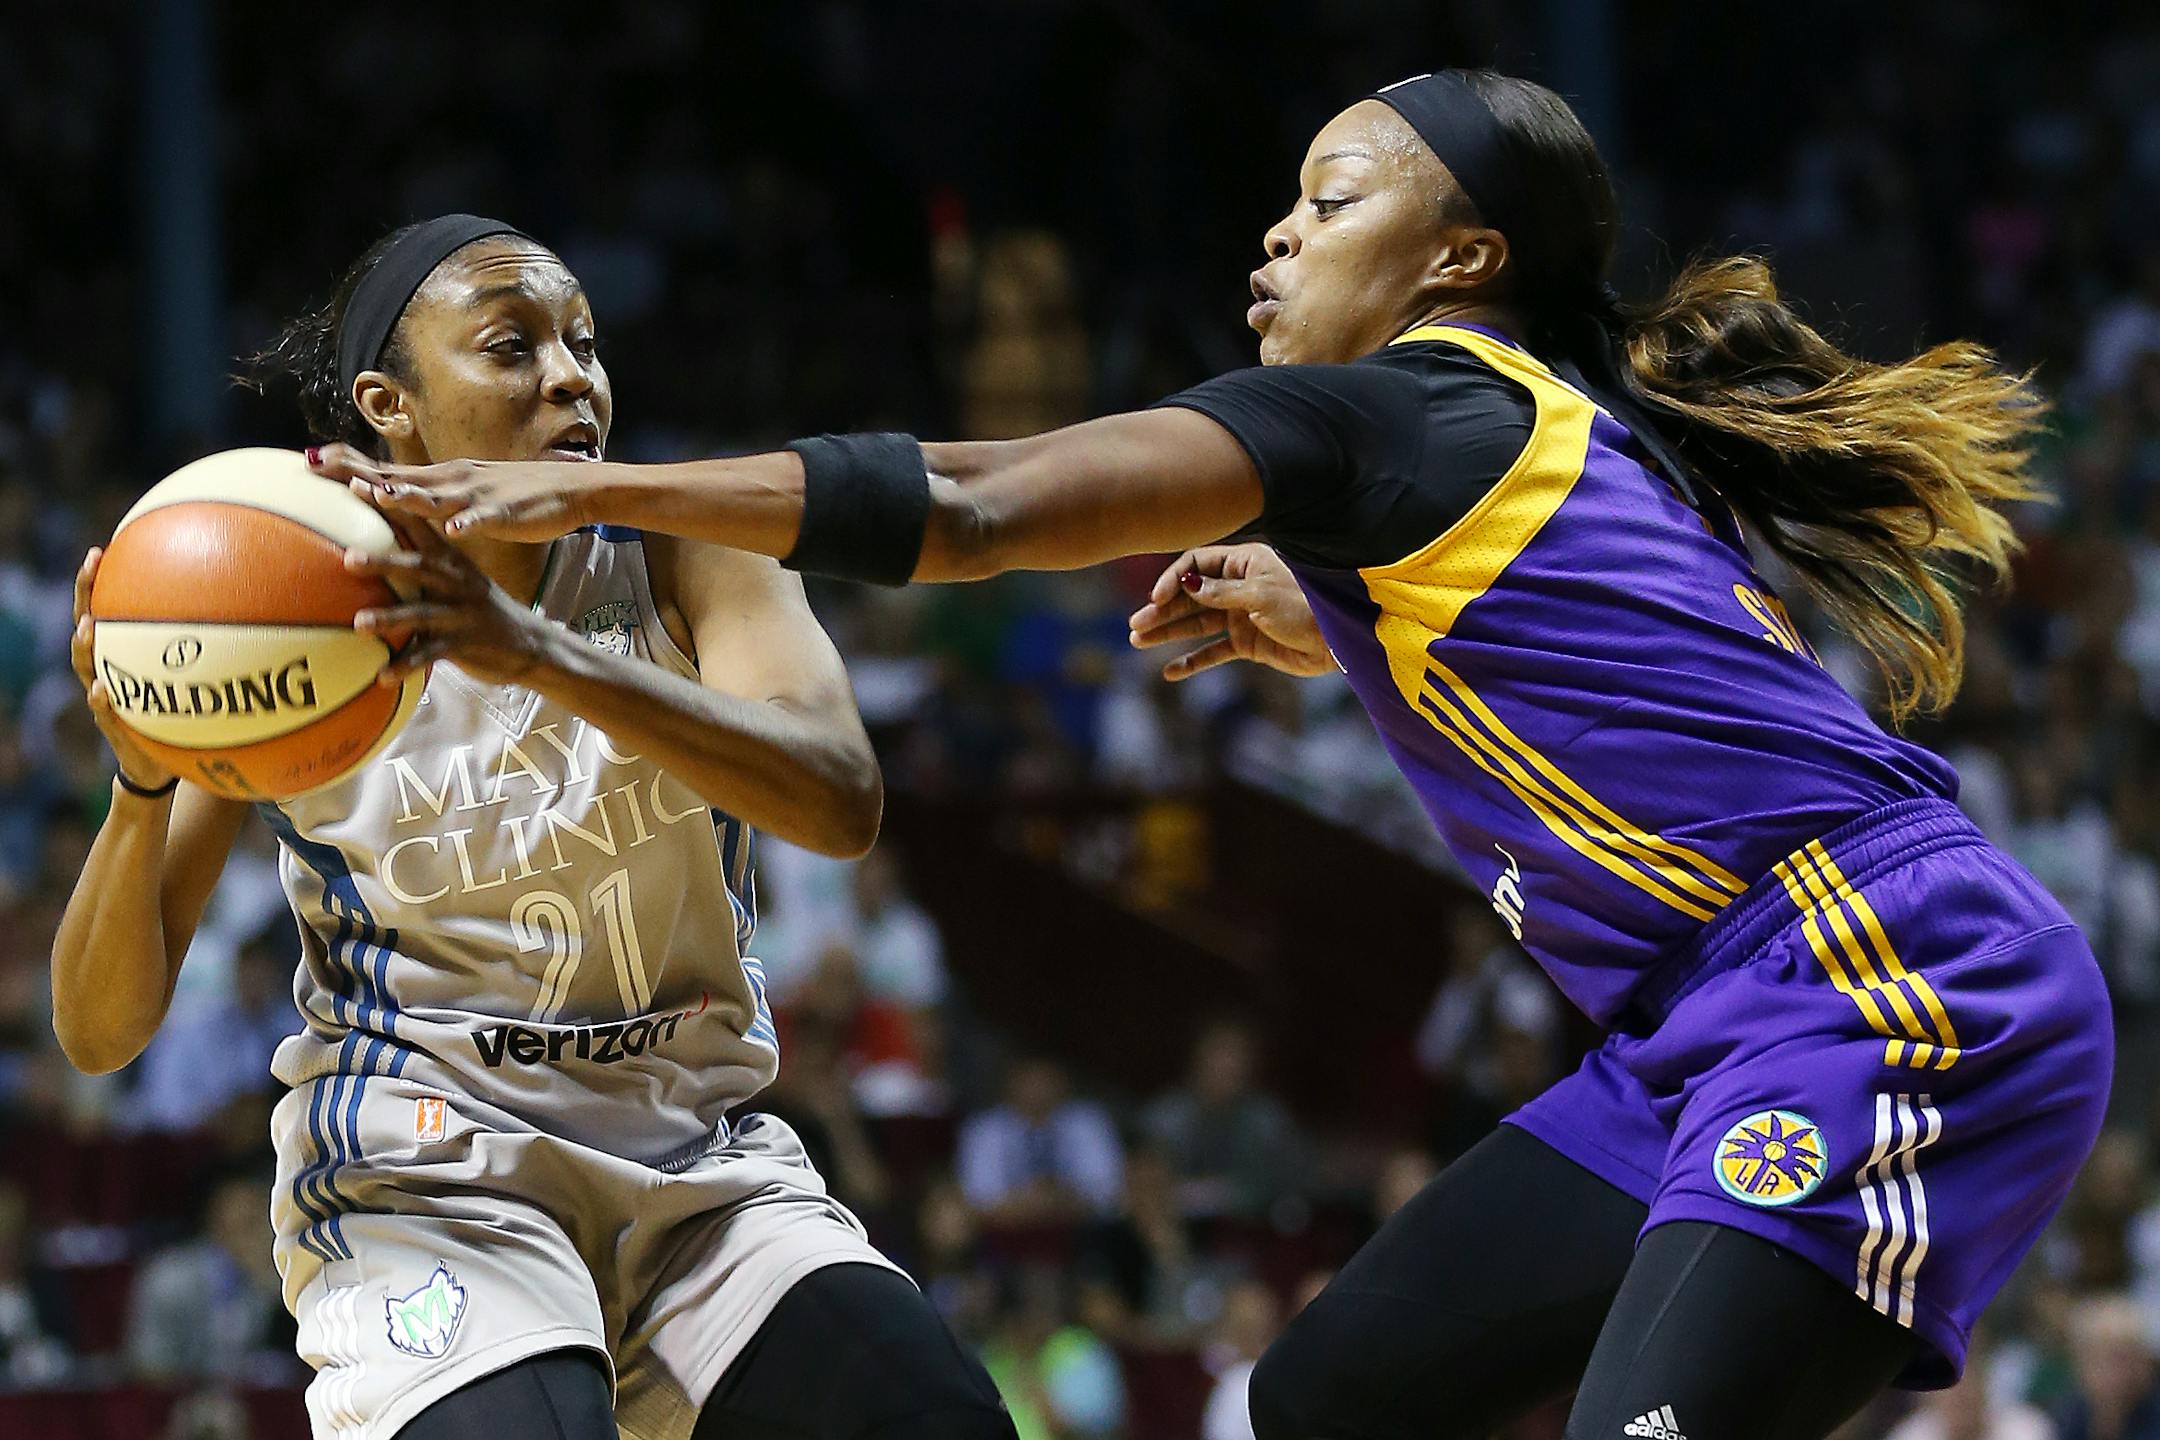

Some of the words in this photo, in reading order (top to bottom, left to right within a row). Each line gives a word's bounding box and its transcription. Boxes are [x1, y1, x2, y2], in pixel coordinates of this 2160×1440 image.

[102, 655, 317, 715] SPALDING
[381, 769, 706, 905] CLINIC
[510, 868, 652, 1025] 21
[470, 1013, 681, 1067] verizon
